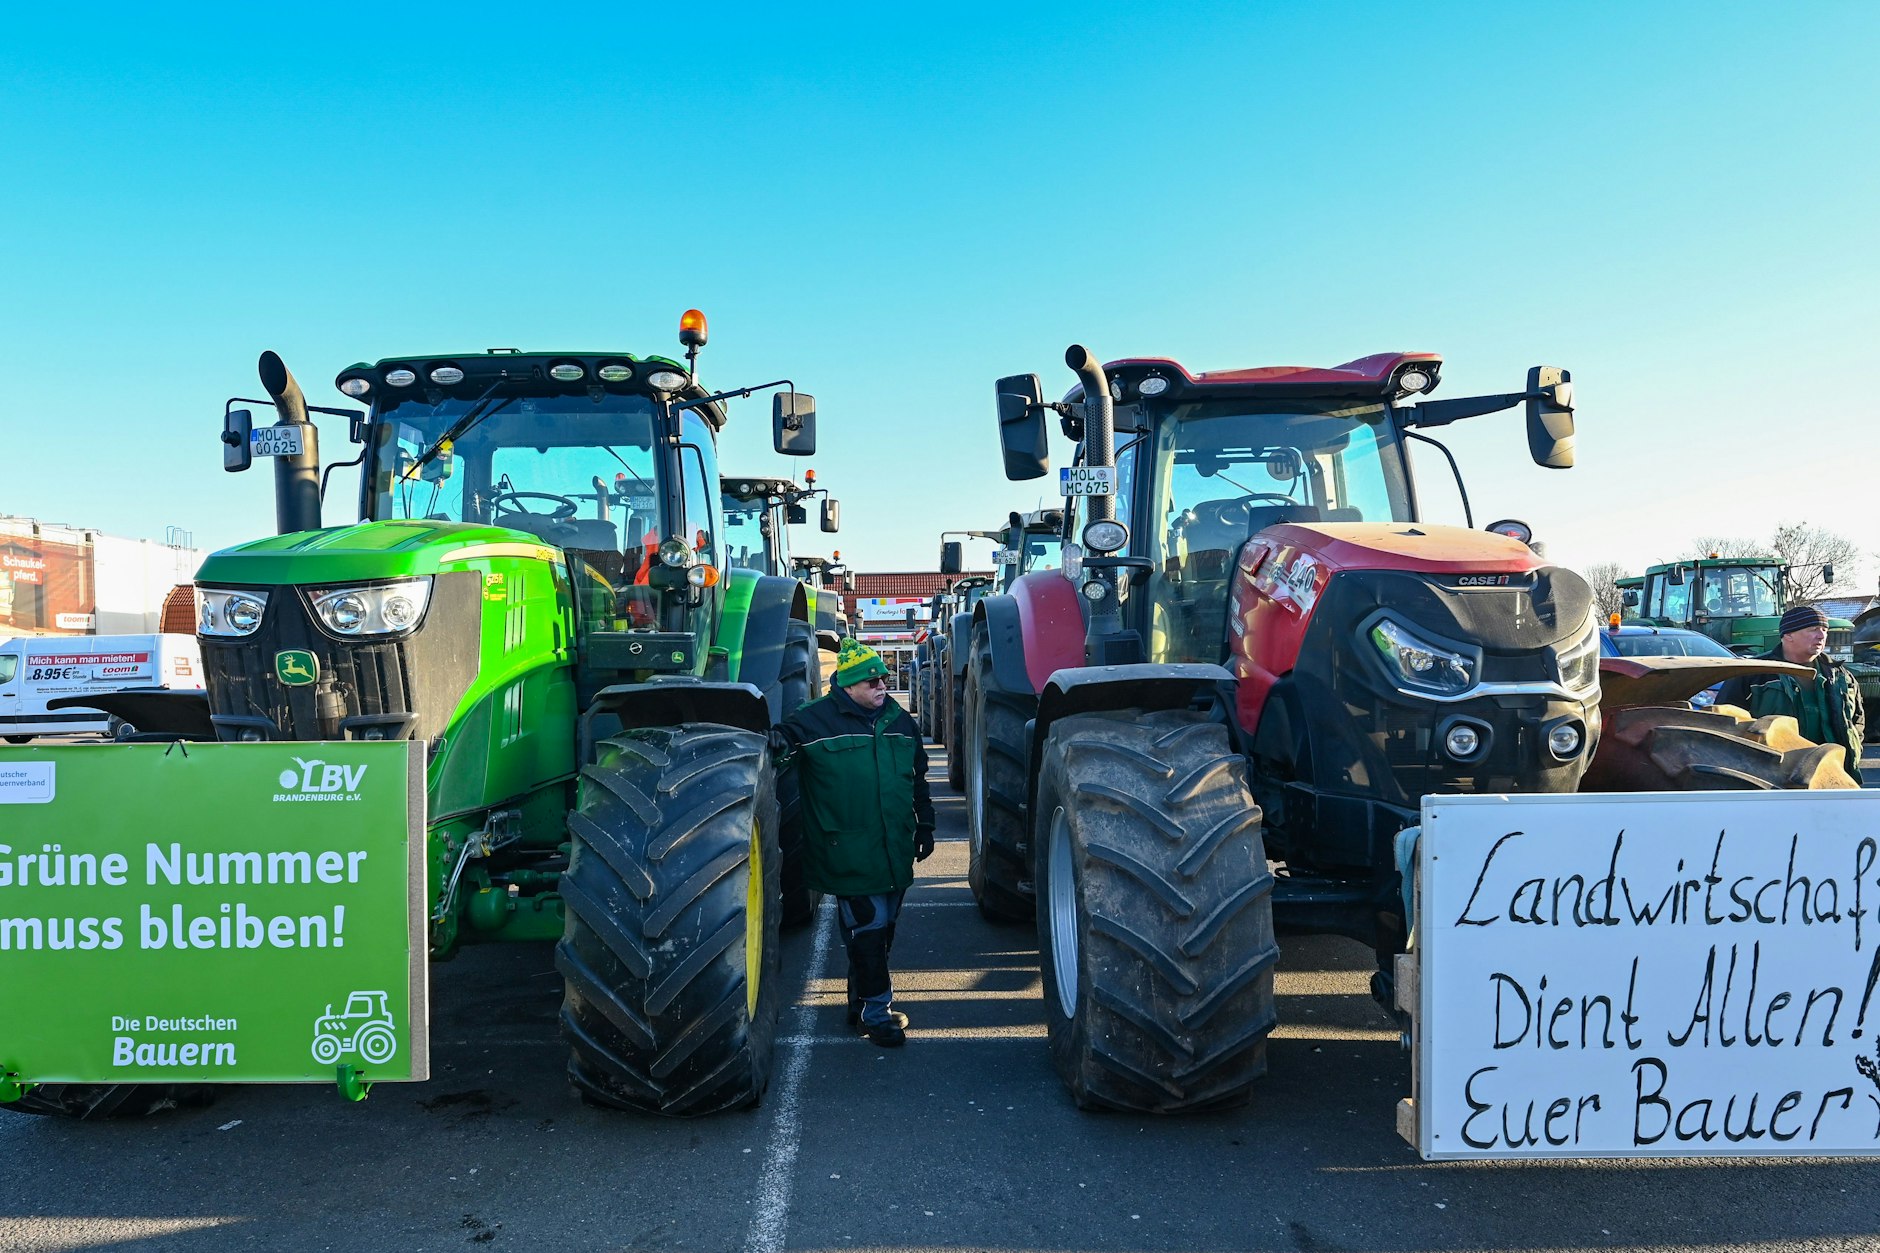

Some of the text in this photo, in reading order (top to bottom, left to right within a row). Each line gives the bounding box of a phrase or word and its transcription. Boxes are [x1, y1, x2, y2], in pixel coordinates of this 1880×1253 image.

[257, 429, 281, 441] MOL
[273, 441, 297, 454] 625
[1070, 469, 1095, 481] MOL
[1066, 481, 1109, 494] MC 675
[2, 555, 47, 570] Schaukel-
[13, 569, 39, 583] pferd.
[1286, 558, 1317, 594] 240
[1458, 577, 1496, 586] CASE
[63, 615, 84, 623] toom
[29, 654, 136, 665] Mich kann man mieten!
[300, 758, 368, 793] LBV
[0, 779, 46, 787] uernverband
[272, 793, 362, 802] BRANDENBURG e.V.
[146, 843, 367, 886] Nummer
[1454, 829, 1880, 952] Landwirtschaf
[0, 903, 345, 951] muss bleiben!
[1488, 939, 1880, 1050] Dient Allen!
[111, 1015, 238, 1033] Die Deutschen
[112, 1037, 237, 1067] Bauern
[1459, 1056, 1855, 1150] Euer Bauer
